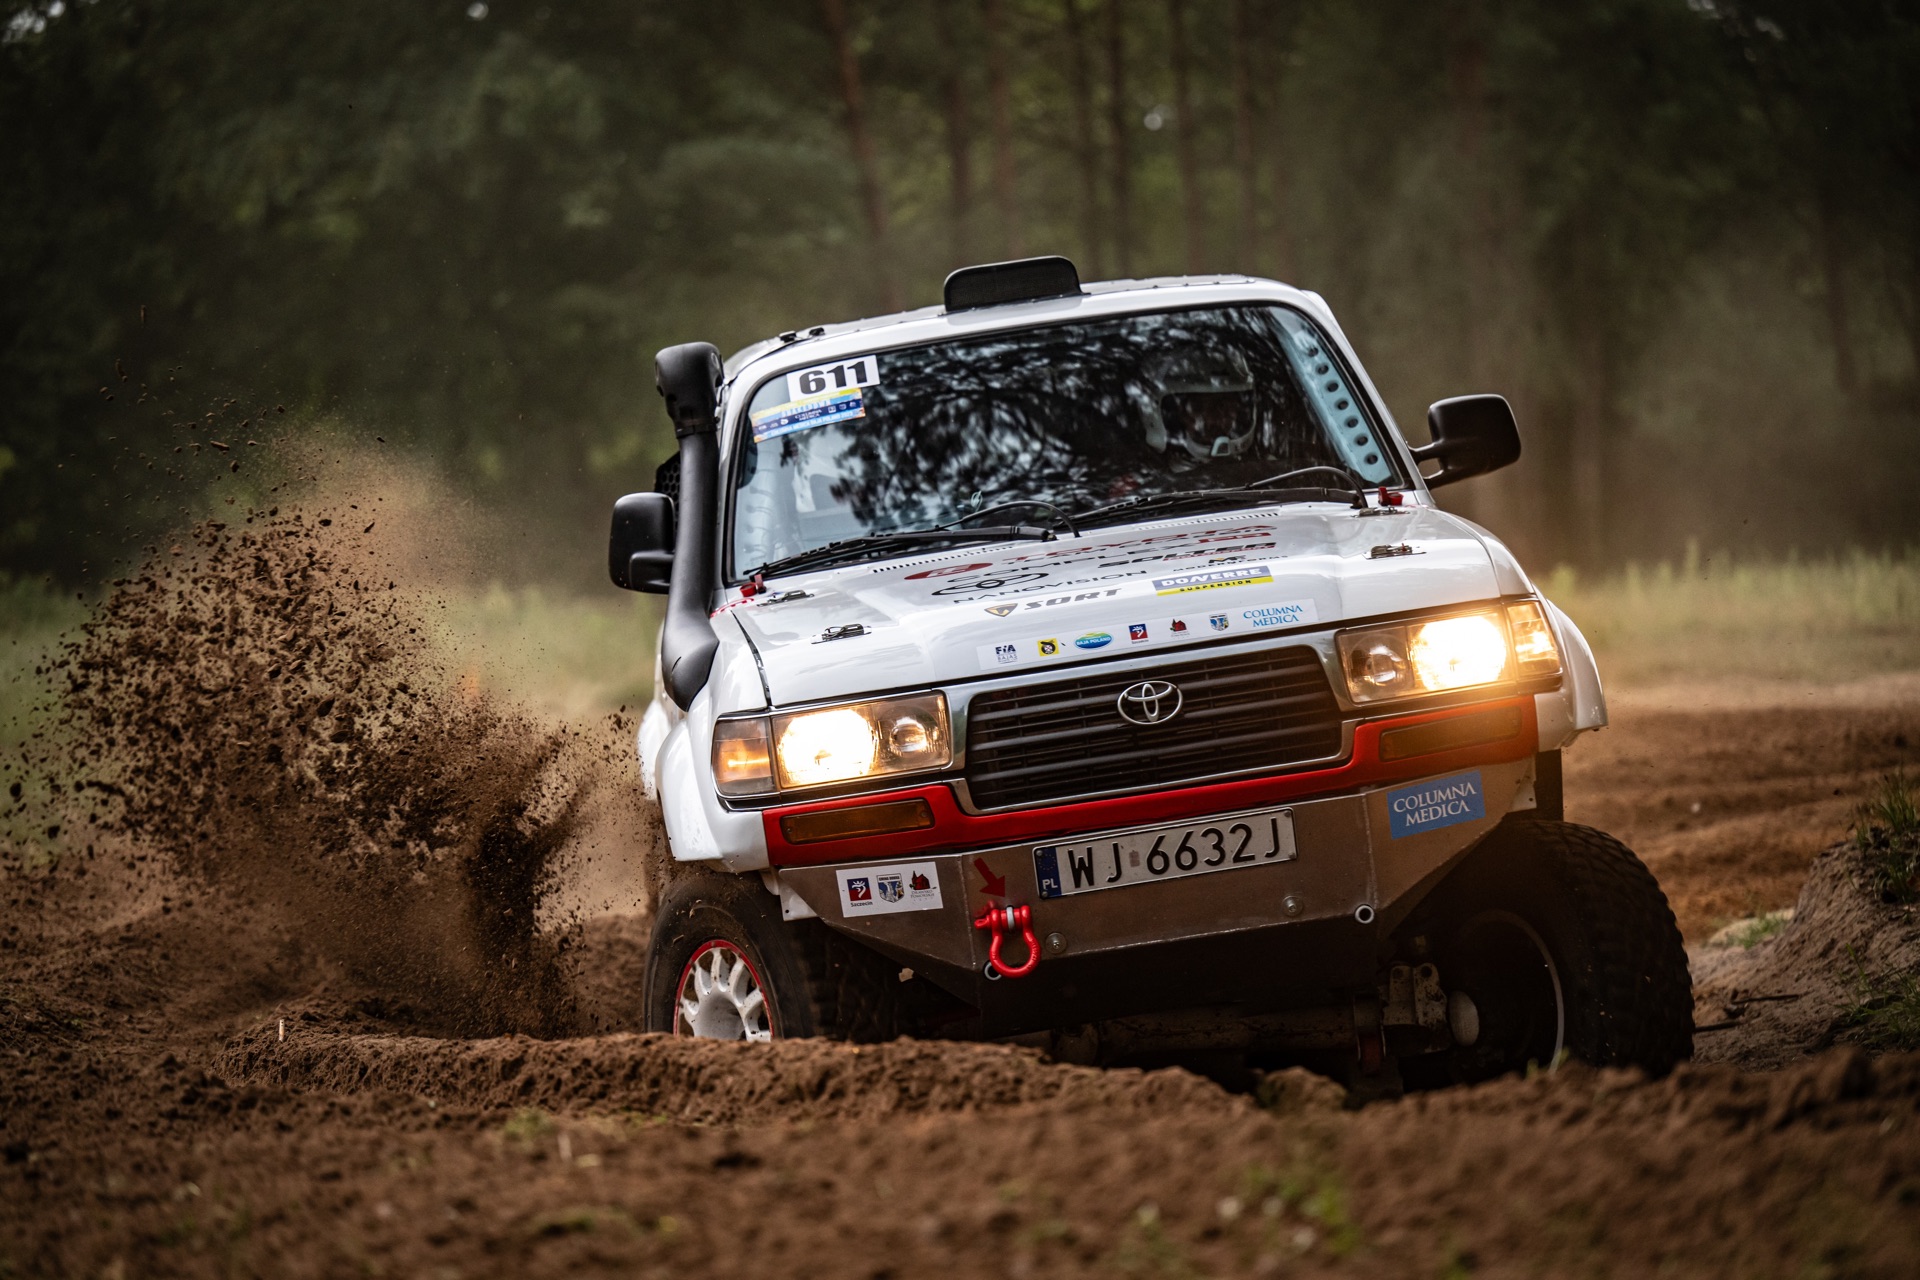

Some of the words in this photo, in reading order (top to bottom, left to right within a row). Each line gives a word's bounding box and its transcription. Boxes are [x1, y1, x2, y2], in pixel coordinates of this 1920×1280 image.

[798, 361, 868, 395] 611
[953, 570, 1148, 603] NANOVISION
[1179, 580, 1252, 592] SUSPENSION
[1023, 588, 1122, 611] SORT
[1242, 604, 1303, 619] COLUMNA
[1253, 614, 1299, 628] MEDICA
[1090, 636, 1111, 644] POLAND
[1393, 781, 1478, 813] COLUMNA
[1405, 799, 1471, 827] MEDICA
[1067, 841, 1123, 889] WJ
[1146, 816, 1280, 876] 6632J
[1042, 878, 1058, 890] PL
